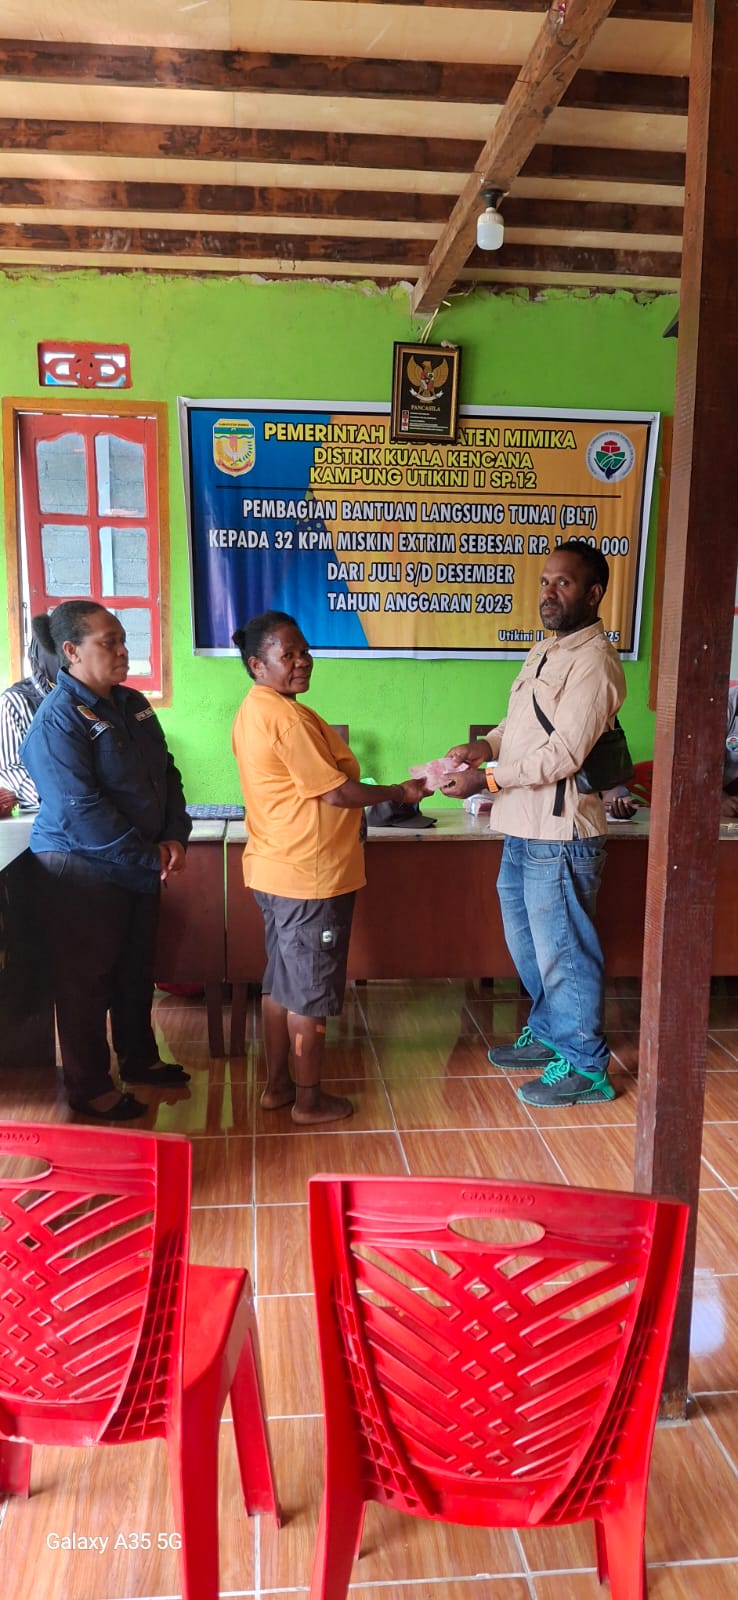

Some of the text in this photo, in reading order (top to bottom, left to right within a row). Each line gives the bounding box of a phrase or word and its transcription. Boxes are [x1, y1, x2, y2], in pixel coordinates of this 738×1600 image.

[263, 422, 385, 443] PEMERINTAH
[503, 428, 577, 449] MIMIKA
[313, 447, 534, 469] DISTRIK KUALA KENCANA
[309, 466, 537, 489] KAMPUNG UTIKINI II SP.12
[242, 499, 598, 529] PEMBAGIAN BANTUAN LANGSUNG TUNAI (BLT)
[208, 529, 270, 549] KEPADA
[274, 531, 294, 549] 32
[298, 531, 334, 550] KPM
[337, 532, 394, 552] MISKIN
[397, 533, 456, 553] EXTRIM
[460, 534, 525, 554] SEBESAR
[528, 536, 550, 555] RP.
[326, 562, 515, 587] DARI JULI S/D DESEMBER
[327, 592, 513, 614] TAHUN ANGGARAN 2025
[498, 629, 534, 642] Utikini
